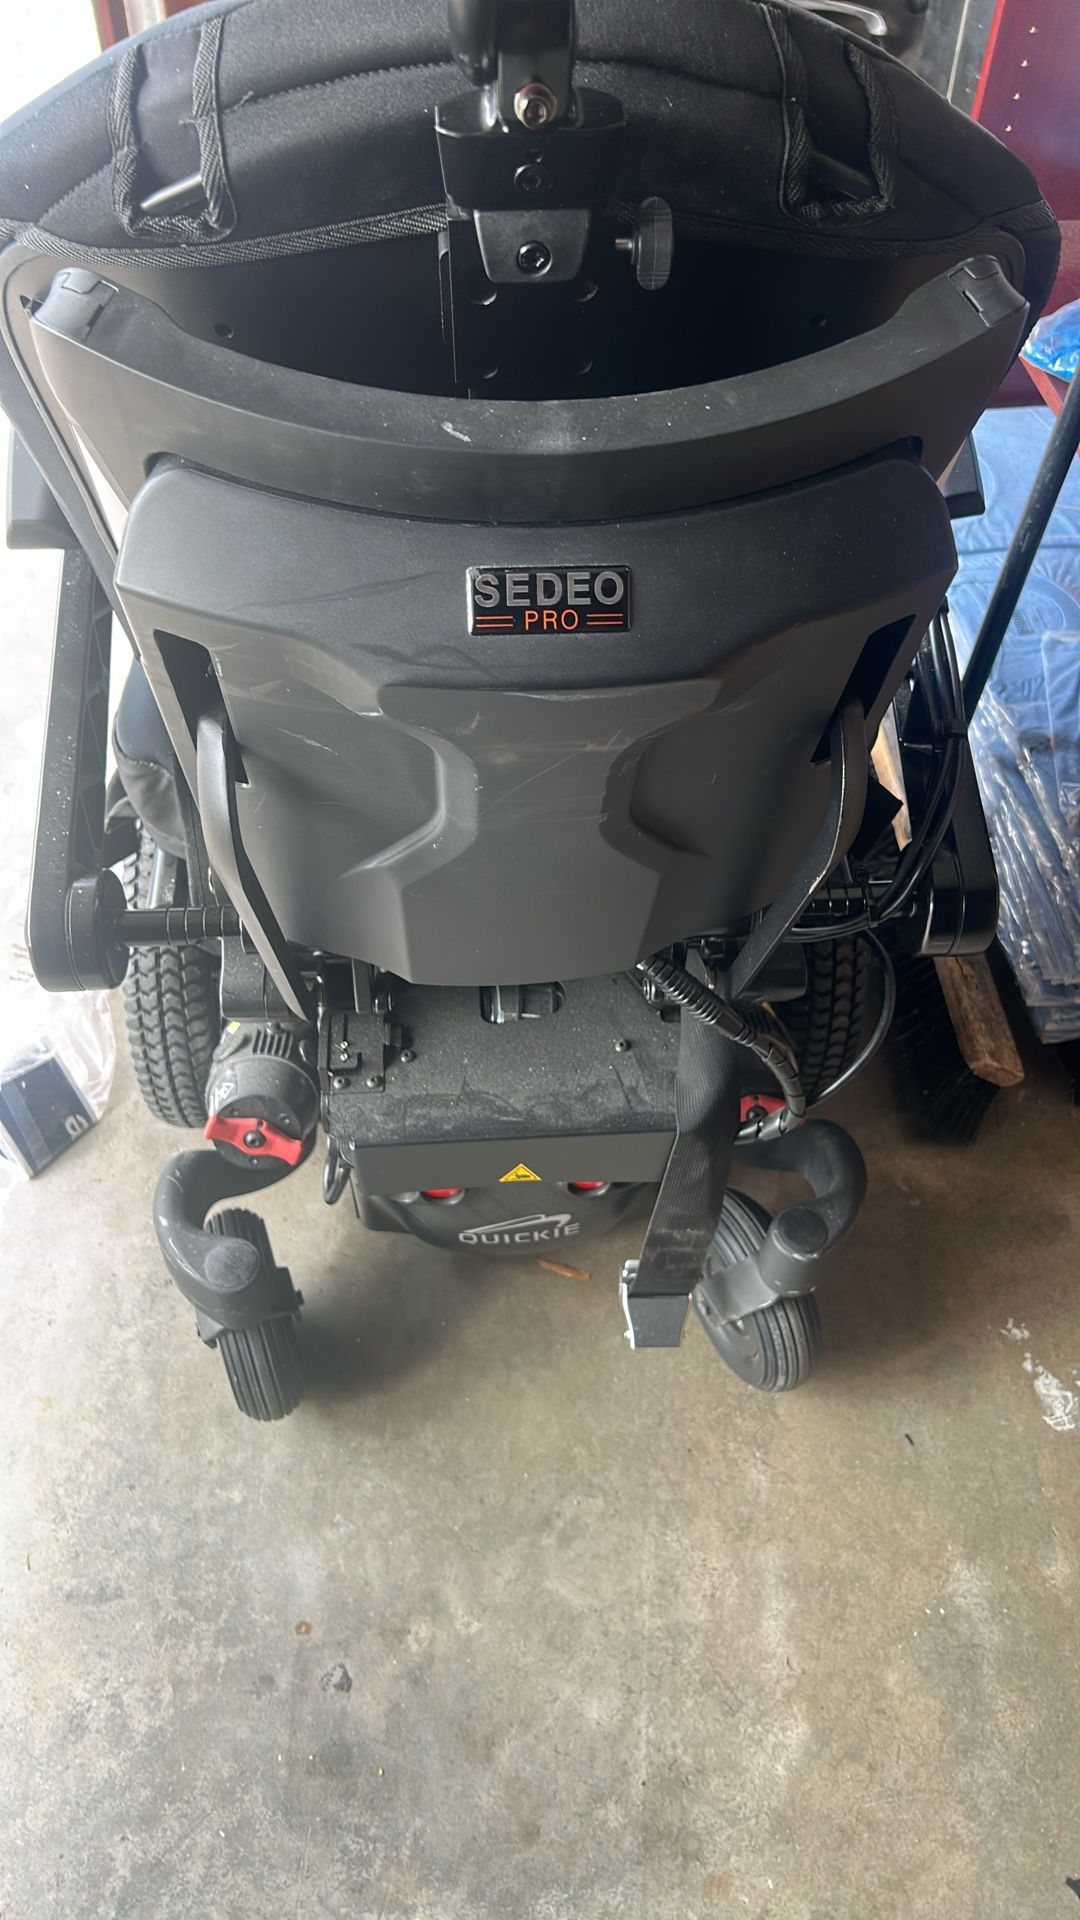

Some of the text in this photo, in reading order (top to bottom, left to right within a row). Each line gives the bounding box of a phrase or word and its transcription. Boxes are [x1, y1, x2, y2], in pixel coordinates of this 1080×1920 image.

[474, 571, 624, 608] SEDEO
[524, 609, 579, 631] PRO
[458, 1222, 580, 1245] QUICKIE
